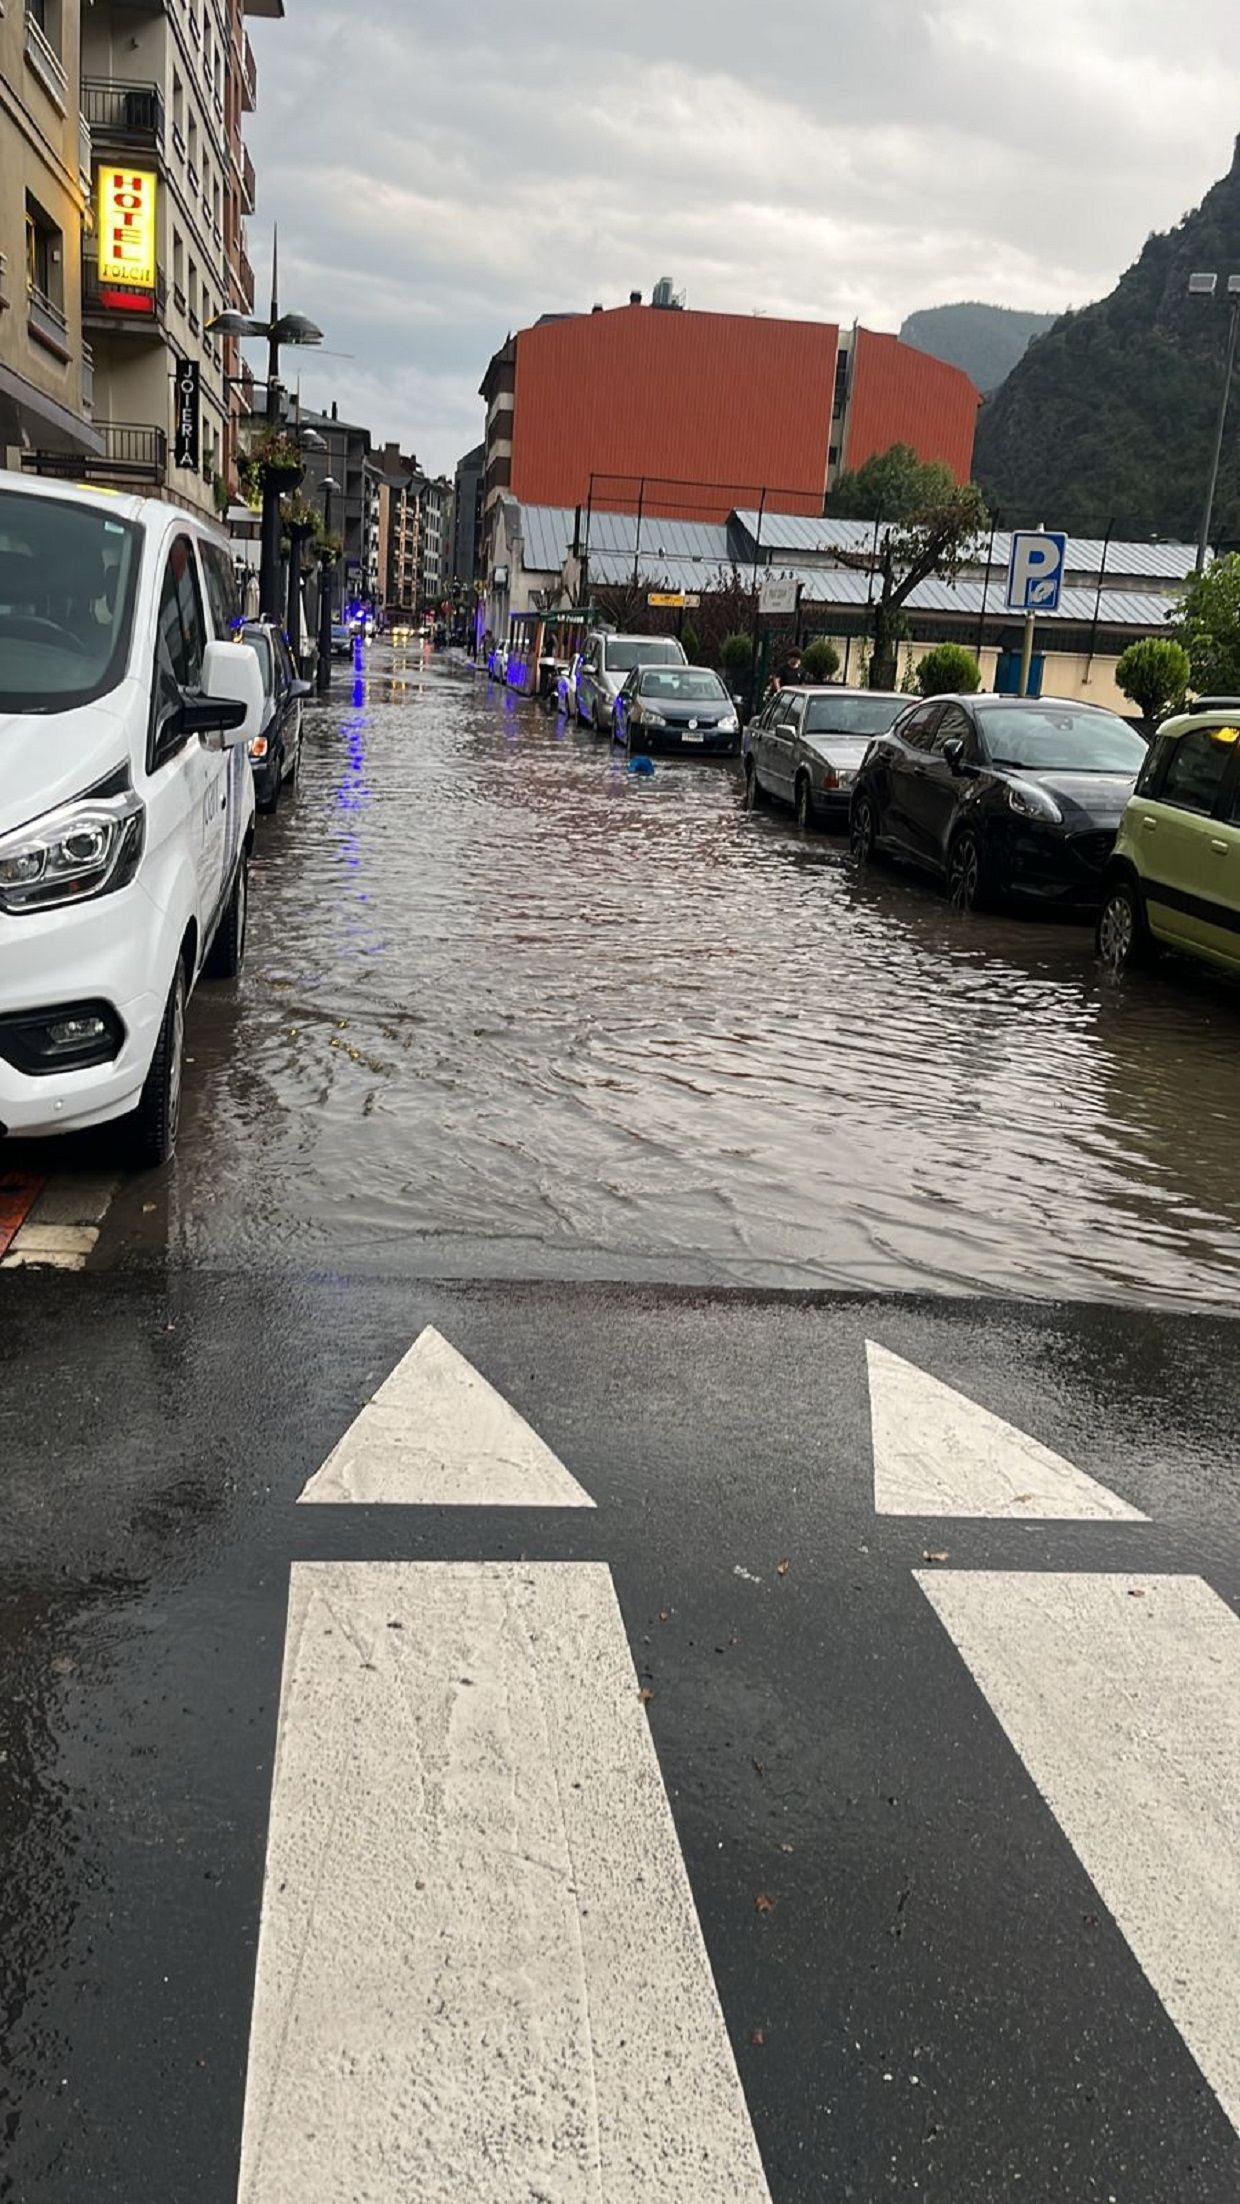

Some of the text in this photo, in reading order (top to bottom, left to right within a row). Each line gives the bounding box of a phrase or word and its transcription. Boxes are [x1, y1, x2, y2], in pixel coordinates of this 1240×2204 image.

[113, 174, 142, 260] HOTEL
[179, 364, 194, 465] JOIERIA
[1009, 535, 1060, 606] P
